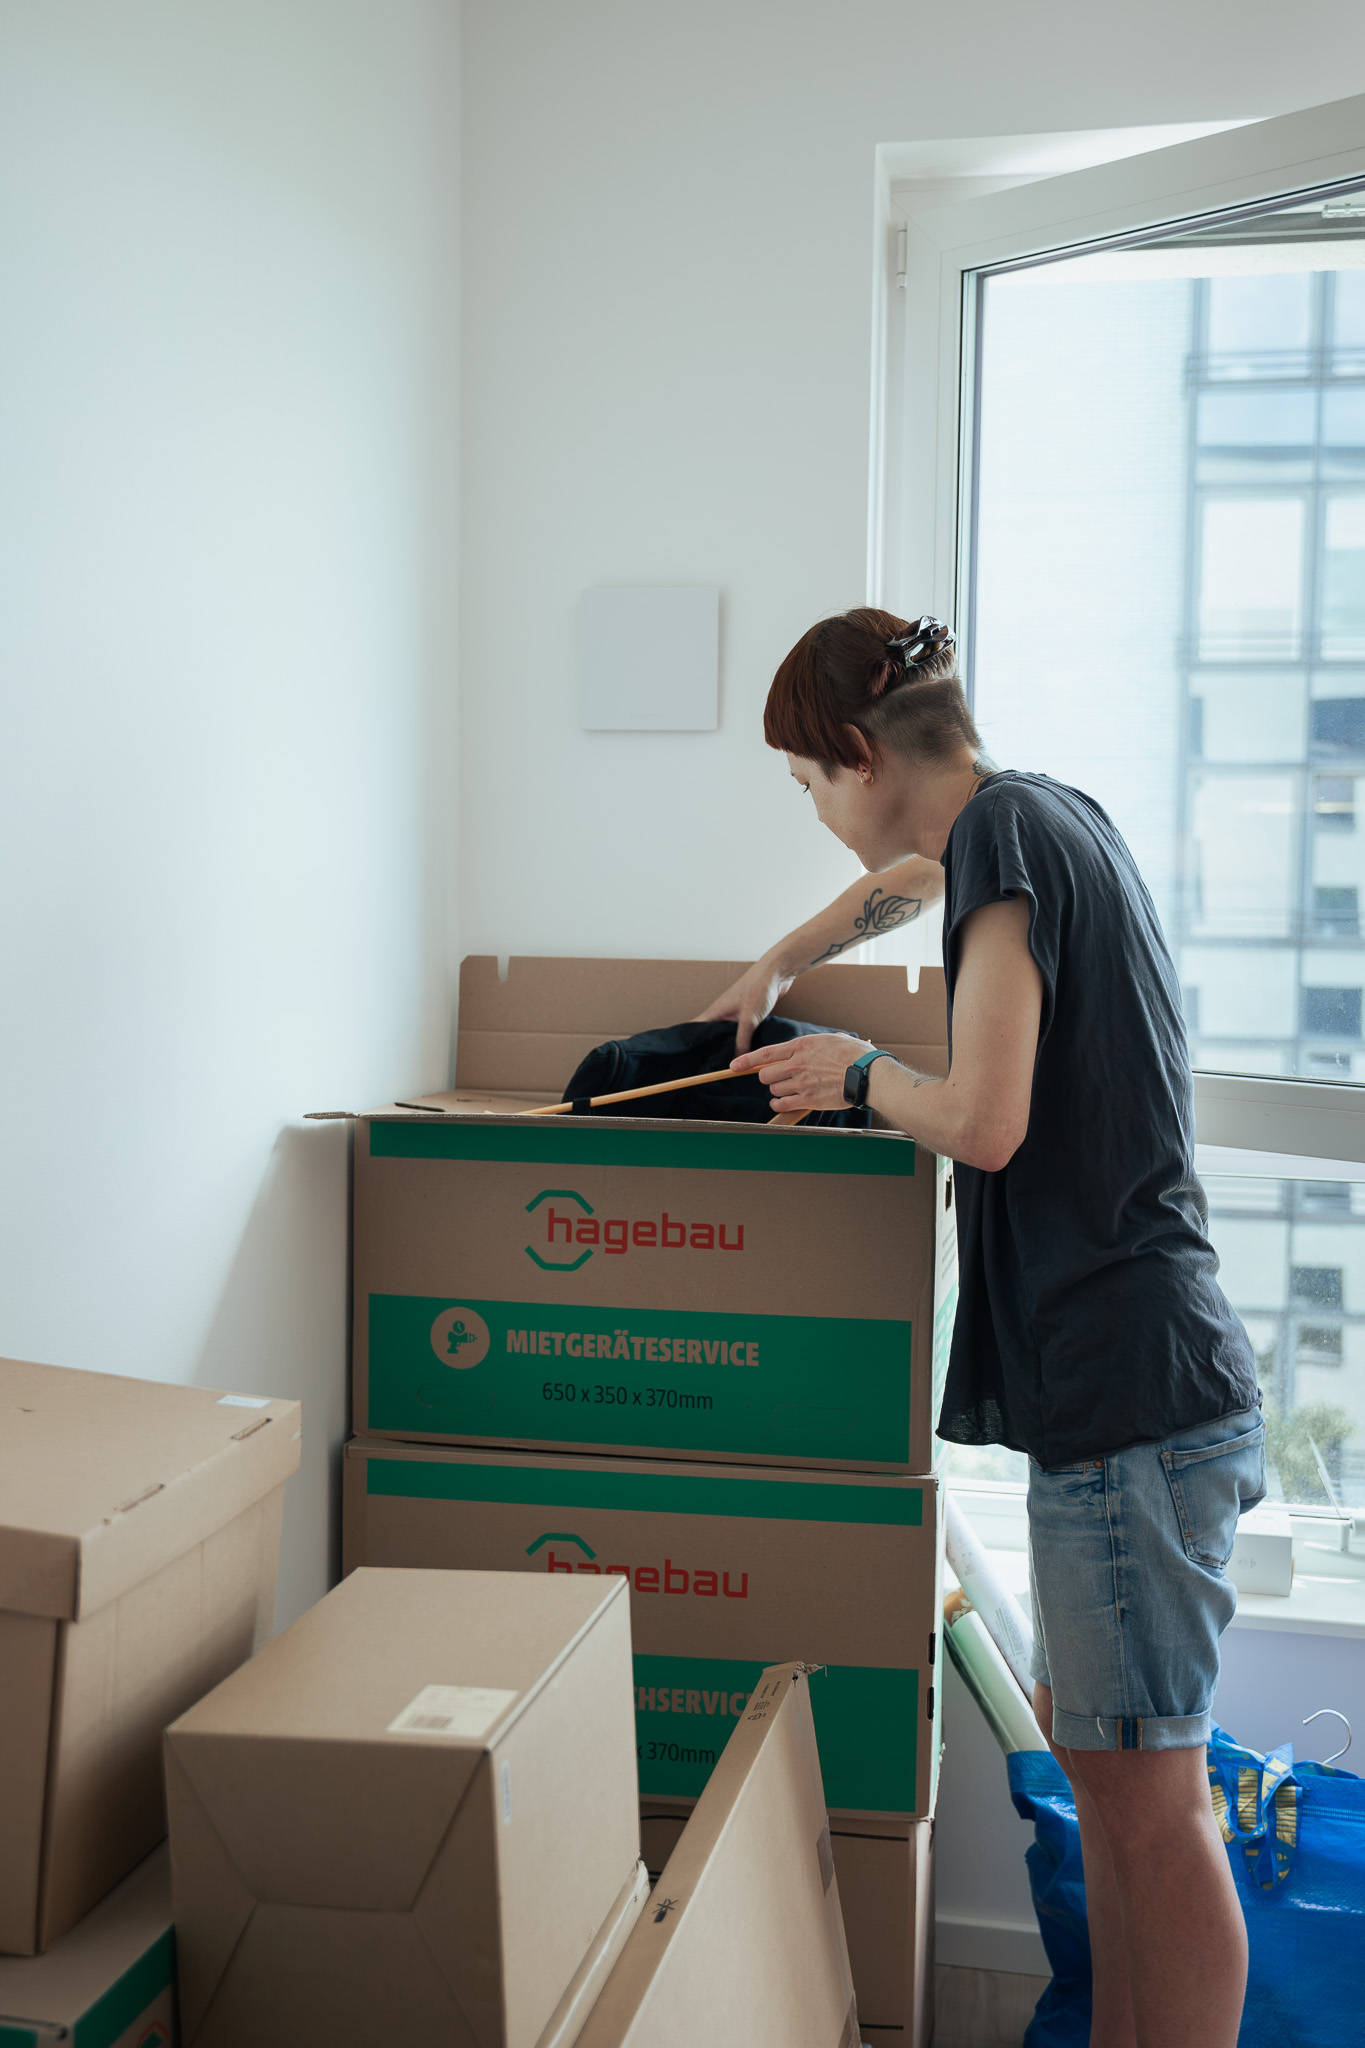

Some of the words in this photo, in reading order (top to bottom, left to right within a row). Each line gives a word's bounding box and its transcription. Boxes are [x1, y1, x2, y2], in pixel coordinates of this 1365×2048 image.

[548, 1208, 744, 1254] hagebau
[506, 1329, 760, 1367] MIETGERÄTESERVICE
[542, 1382, 576, 1402] 650
[581, 1388, 591, 1403] x
[594, 1385, 628, 1405] 350
[632, 1391, 642, 1406] x
[647, 1388, 714, 1410] 370mm
[634, 1686, 752, 1717] HSERVIC
[647, 1741, 715, 1764] 370mm
